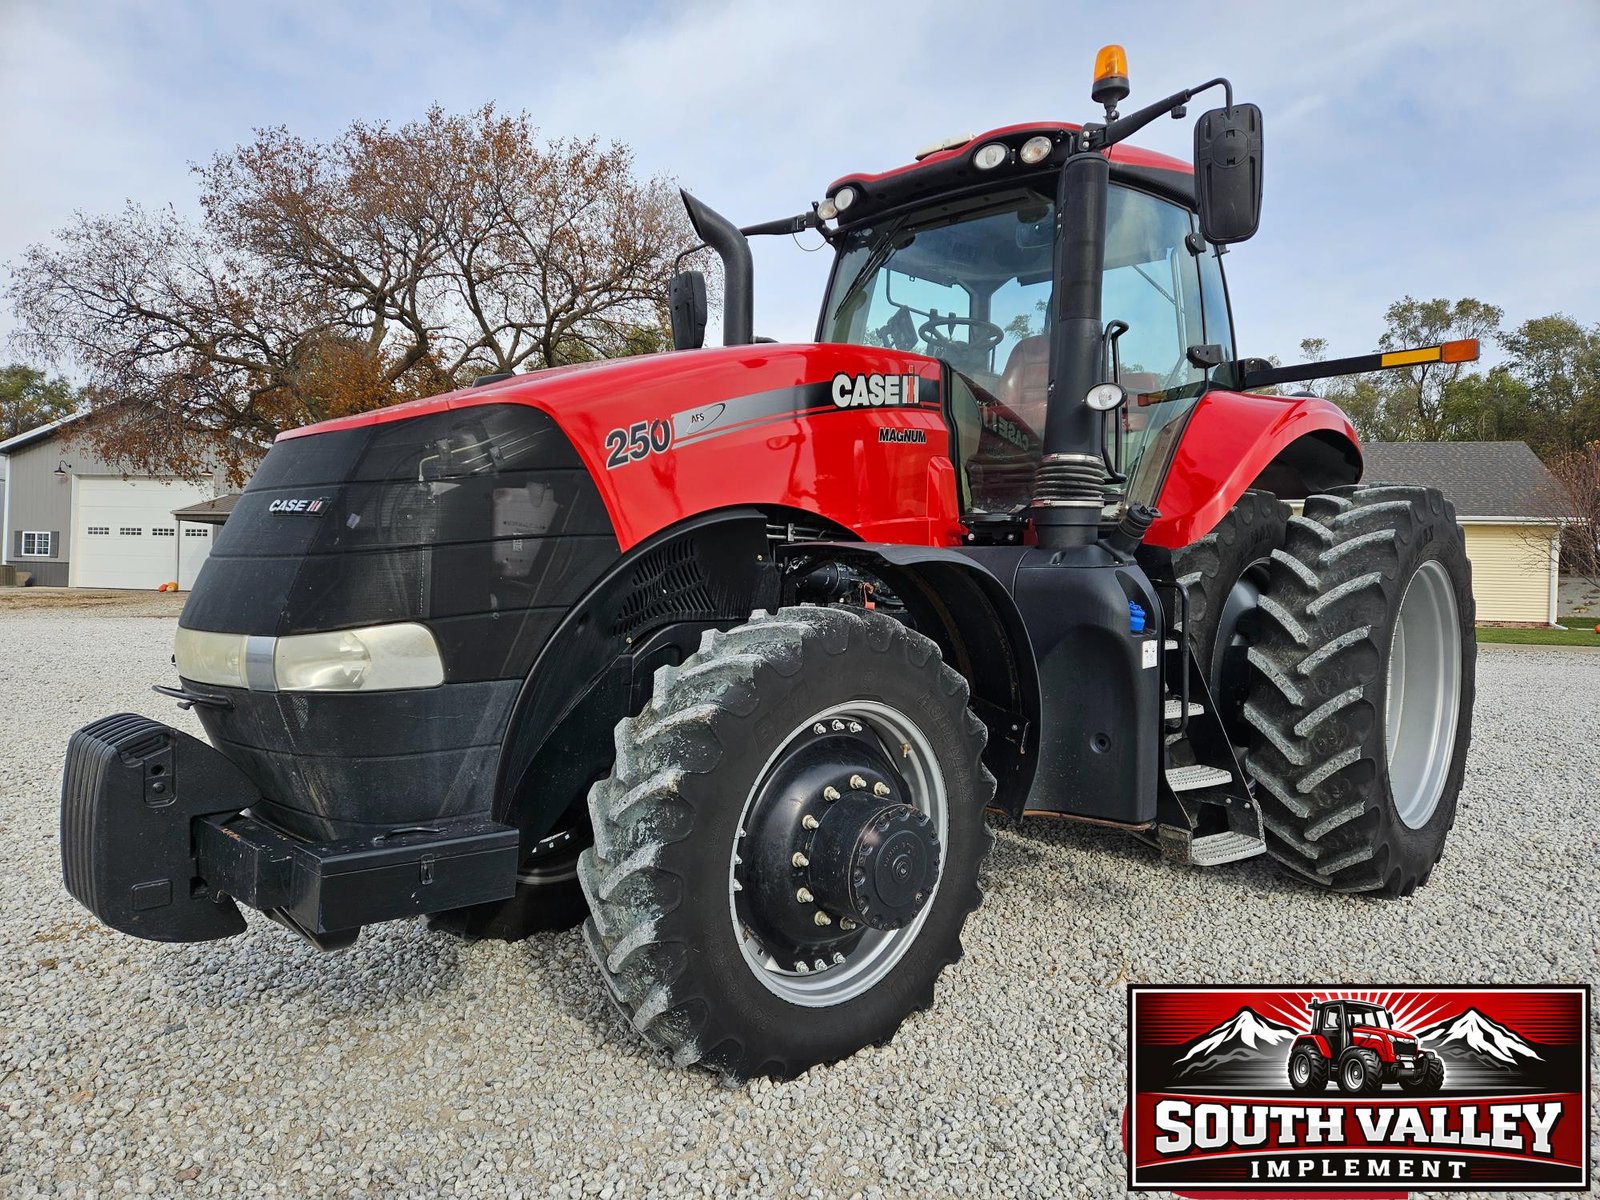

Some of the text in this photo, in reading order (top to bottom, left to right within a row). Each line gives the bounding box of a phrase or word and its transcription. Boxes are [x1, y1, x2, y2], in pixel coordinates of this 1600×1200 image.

[831, 373, 900, 408] CASE
[691, 412, 705, 424] AFS
[605, 417, 671, 470] 250
[878, 427, 927, 444] MAGNUM
[268, 499, 307, 512] CASE
